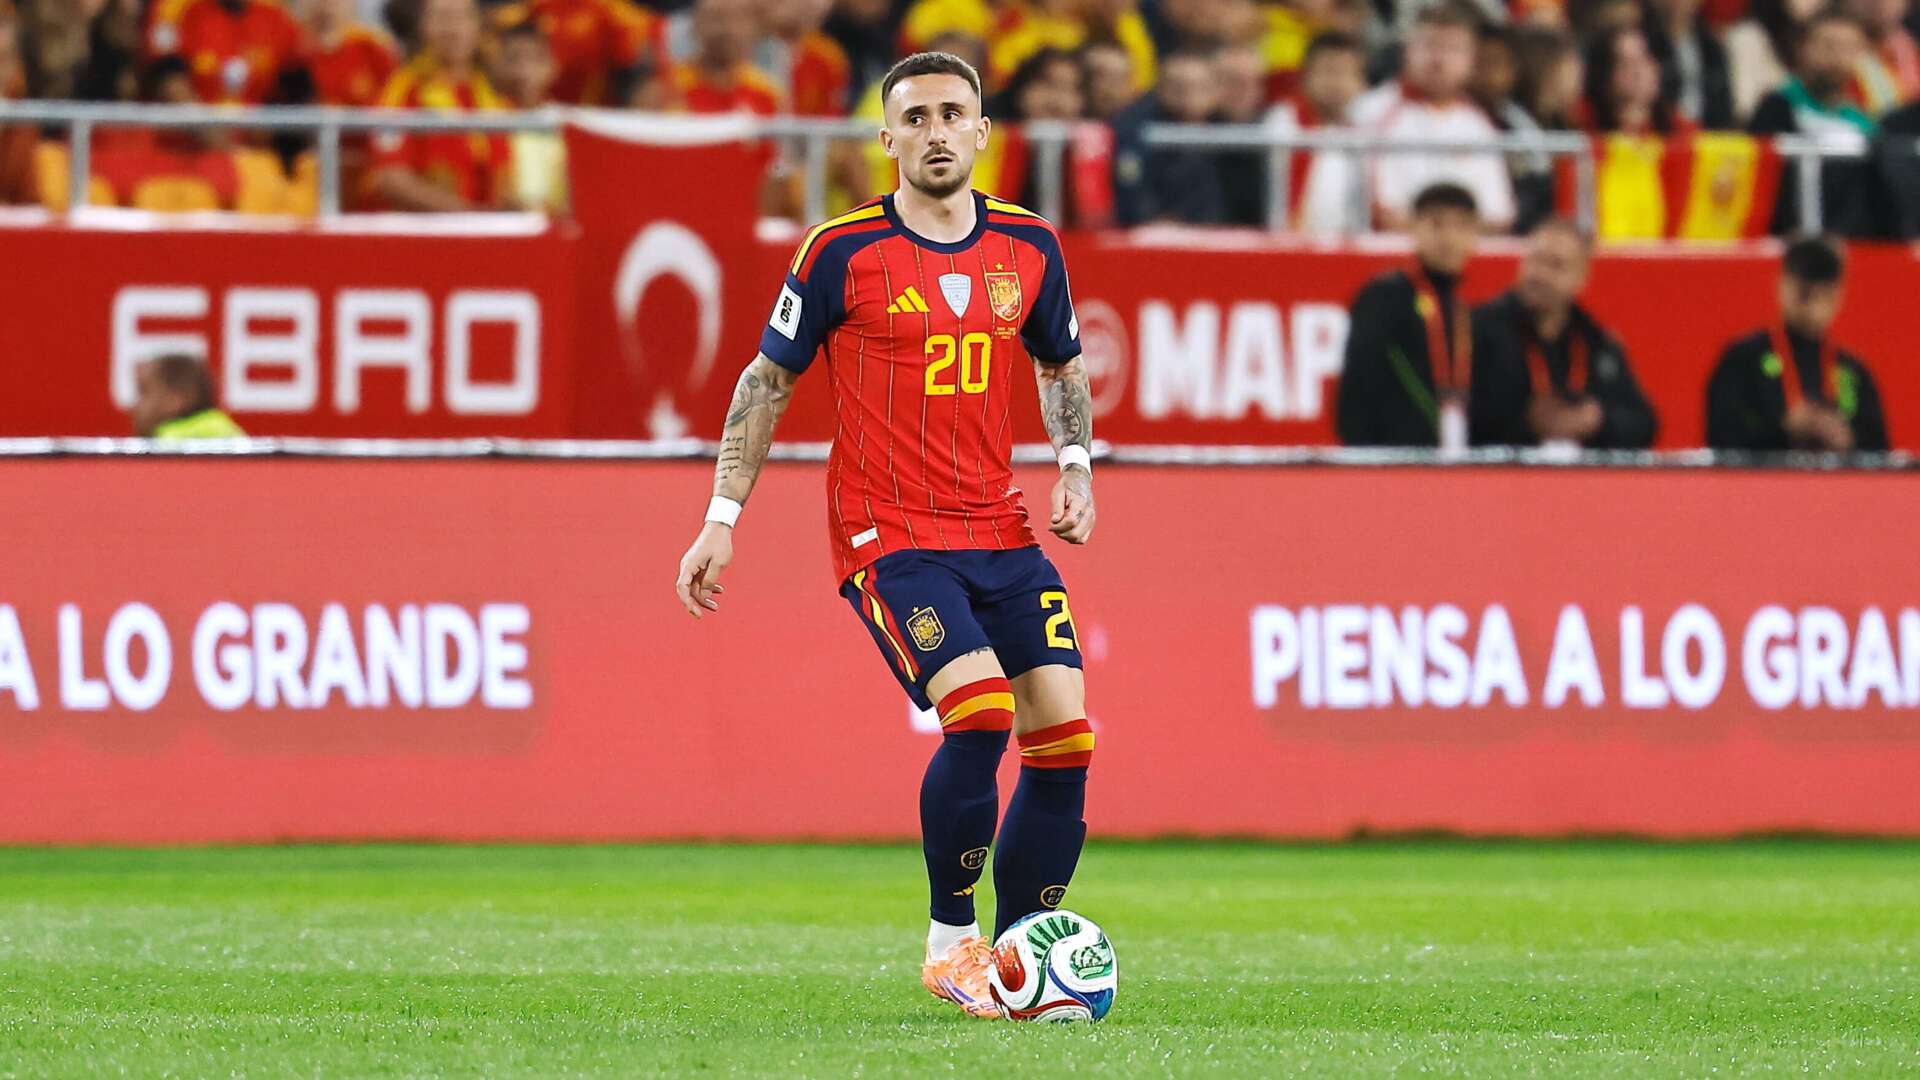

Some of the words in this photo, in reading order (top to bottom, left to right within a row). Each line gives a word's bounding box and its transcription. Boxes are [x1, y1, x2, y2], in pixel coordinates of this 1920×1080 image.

[924, 332, 992, 396] 20
[1136, 299, 1351, 421] MAP
[0, 603, 39, 710] A
[58, 601, 172, 711] LO
[191, 601, 533, 711] GRANDE
[1040, 591, 1076, 650] 2
[1249, 603, 1528, 708] PIENSA
[1543, 604, 1605, 708] A
[1619, 604, 1726, 709] LO
